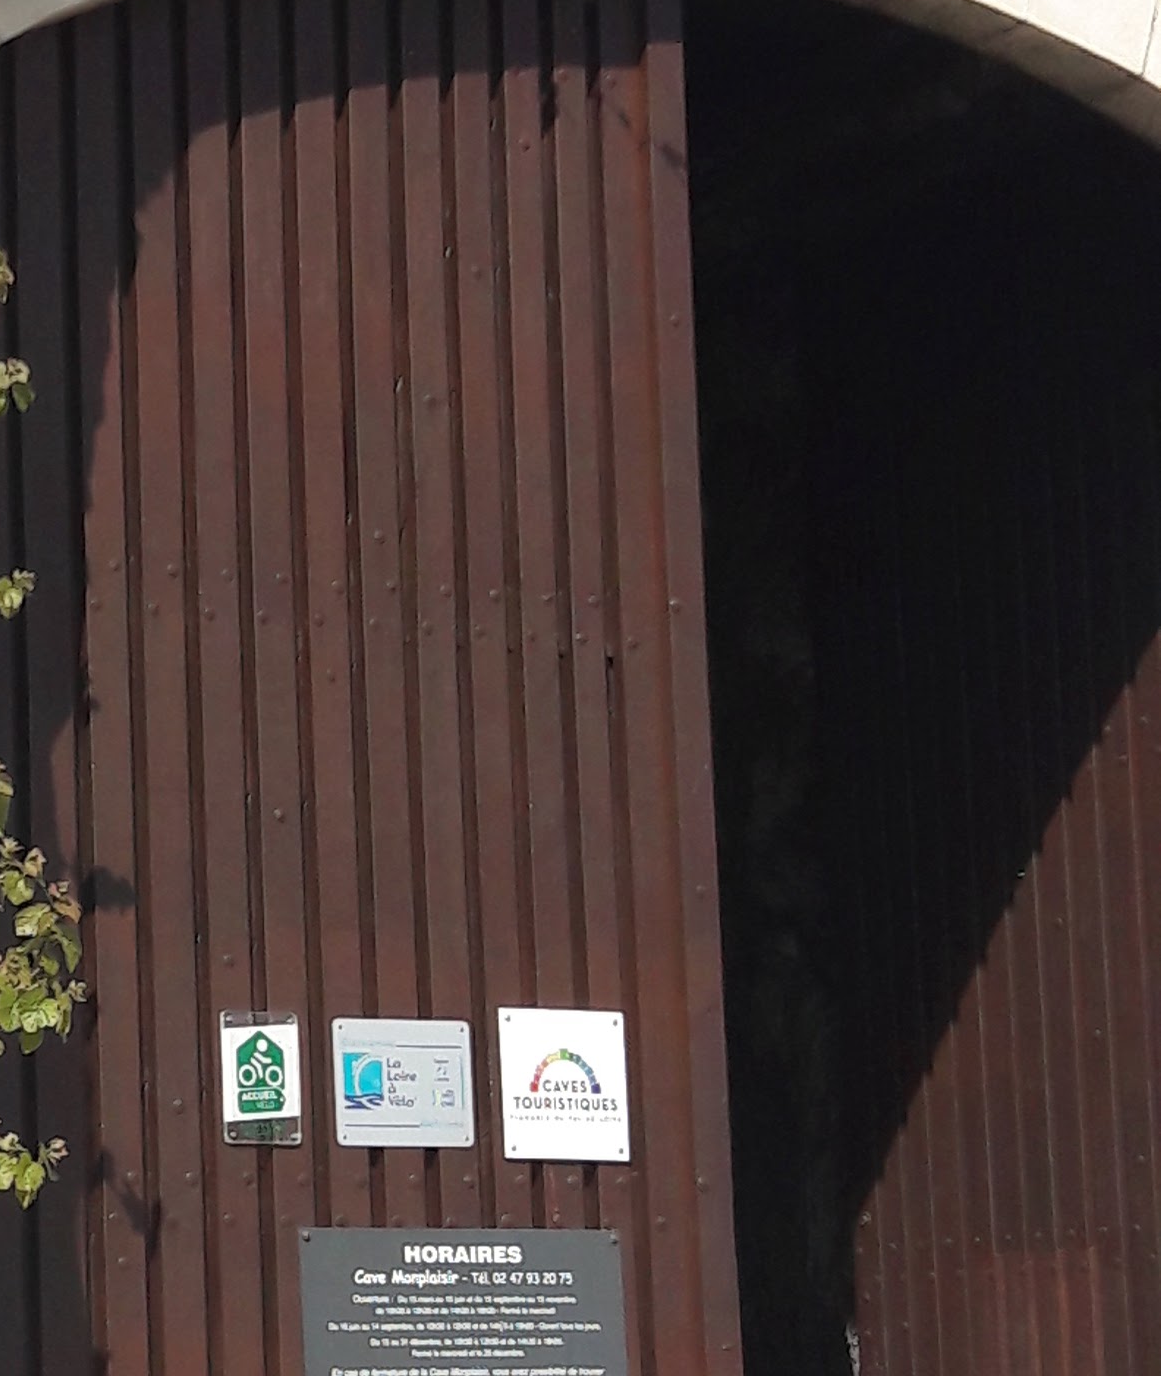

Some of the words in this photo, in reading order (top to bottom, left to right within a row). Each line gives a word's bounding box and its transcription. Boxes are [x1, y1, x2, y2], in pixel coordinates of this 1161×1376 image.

[386, 1057, 401, 1069] La
[386, 1069, 417, 1082] Loire
[542, 1079, 588, 1093] CAVES
[241, 1090, 278, 1101] ACCUEIL
[513, 1096, 618, 1112] TOURISTIQUES
[403, 1245, 523, 1264] HORAIRES
[353, 1269, 387, 1285] Cave
[391, 1269, 460, 1289] Monplaisir
[492, 1272, 507, 1285] 02
[509, 1272, 524, 1285] 47
[526, 1272, 540, 1285] 93
[542, 1272, 557, 1285] 20
